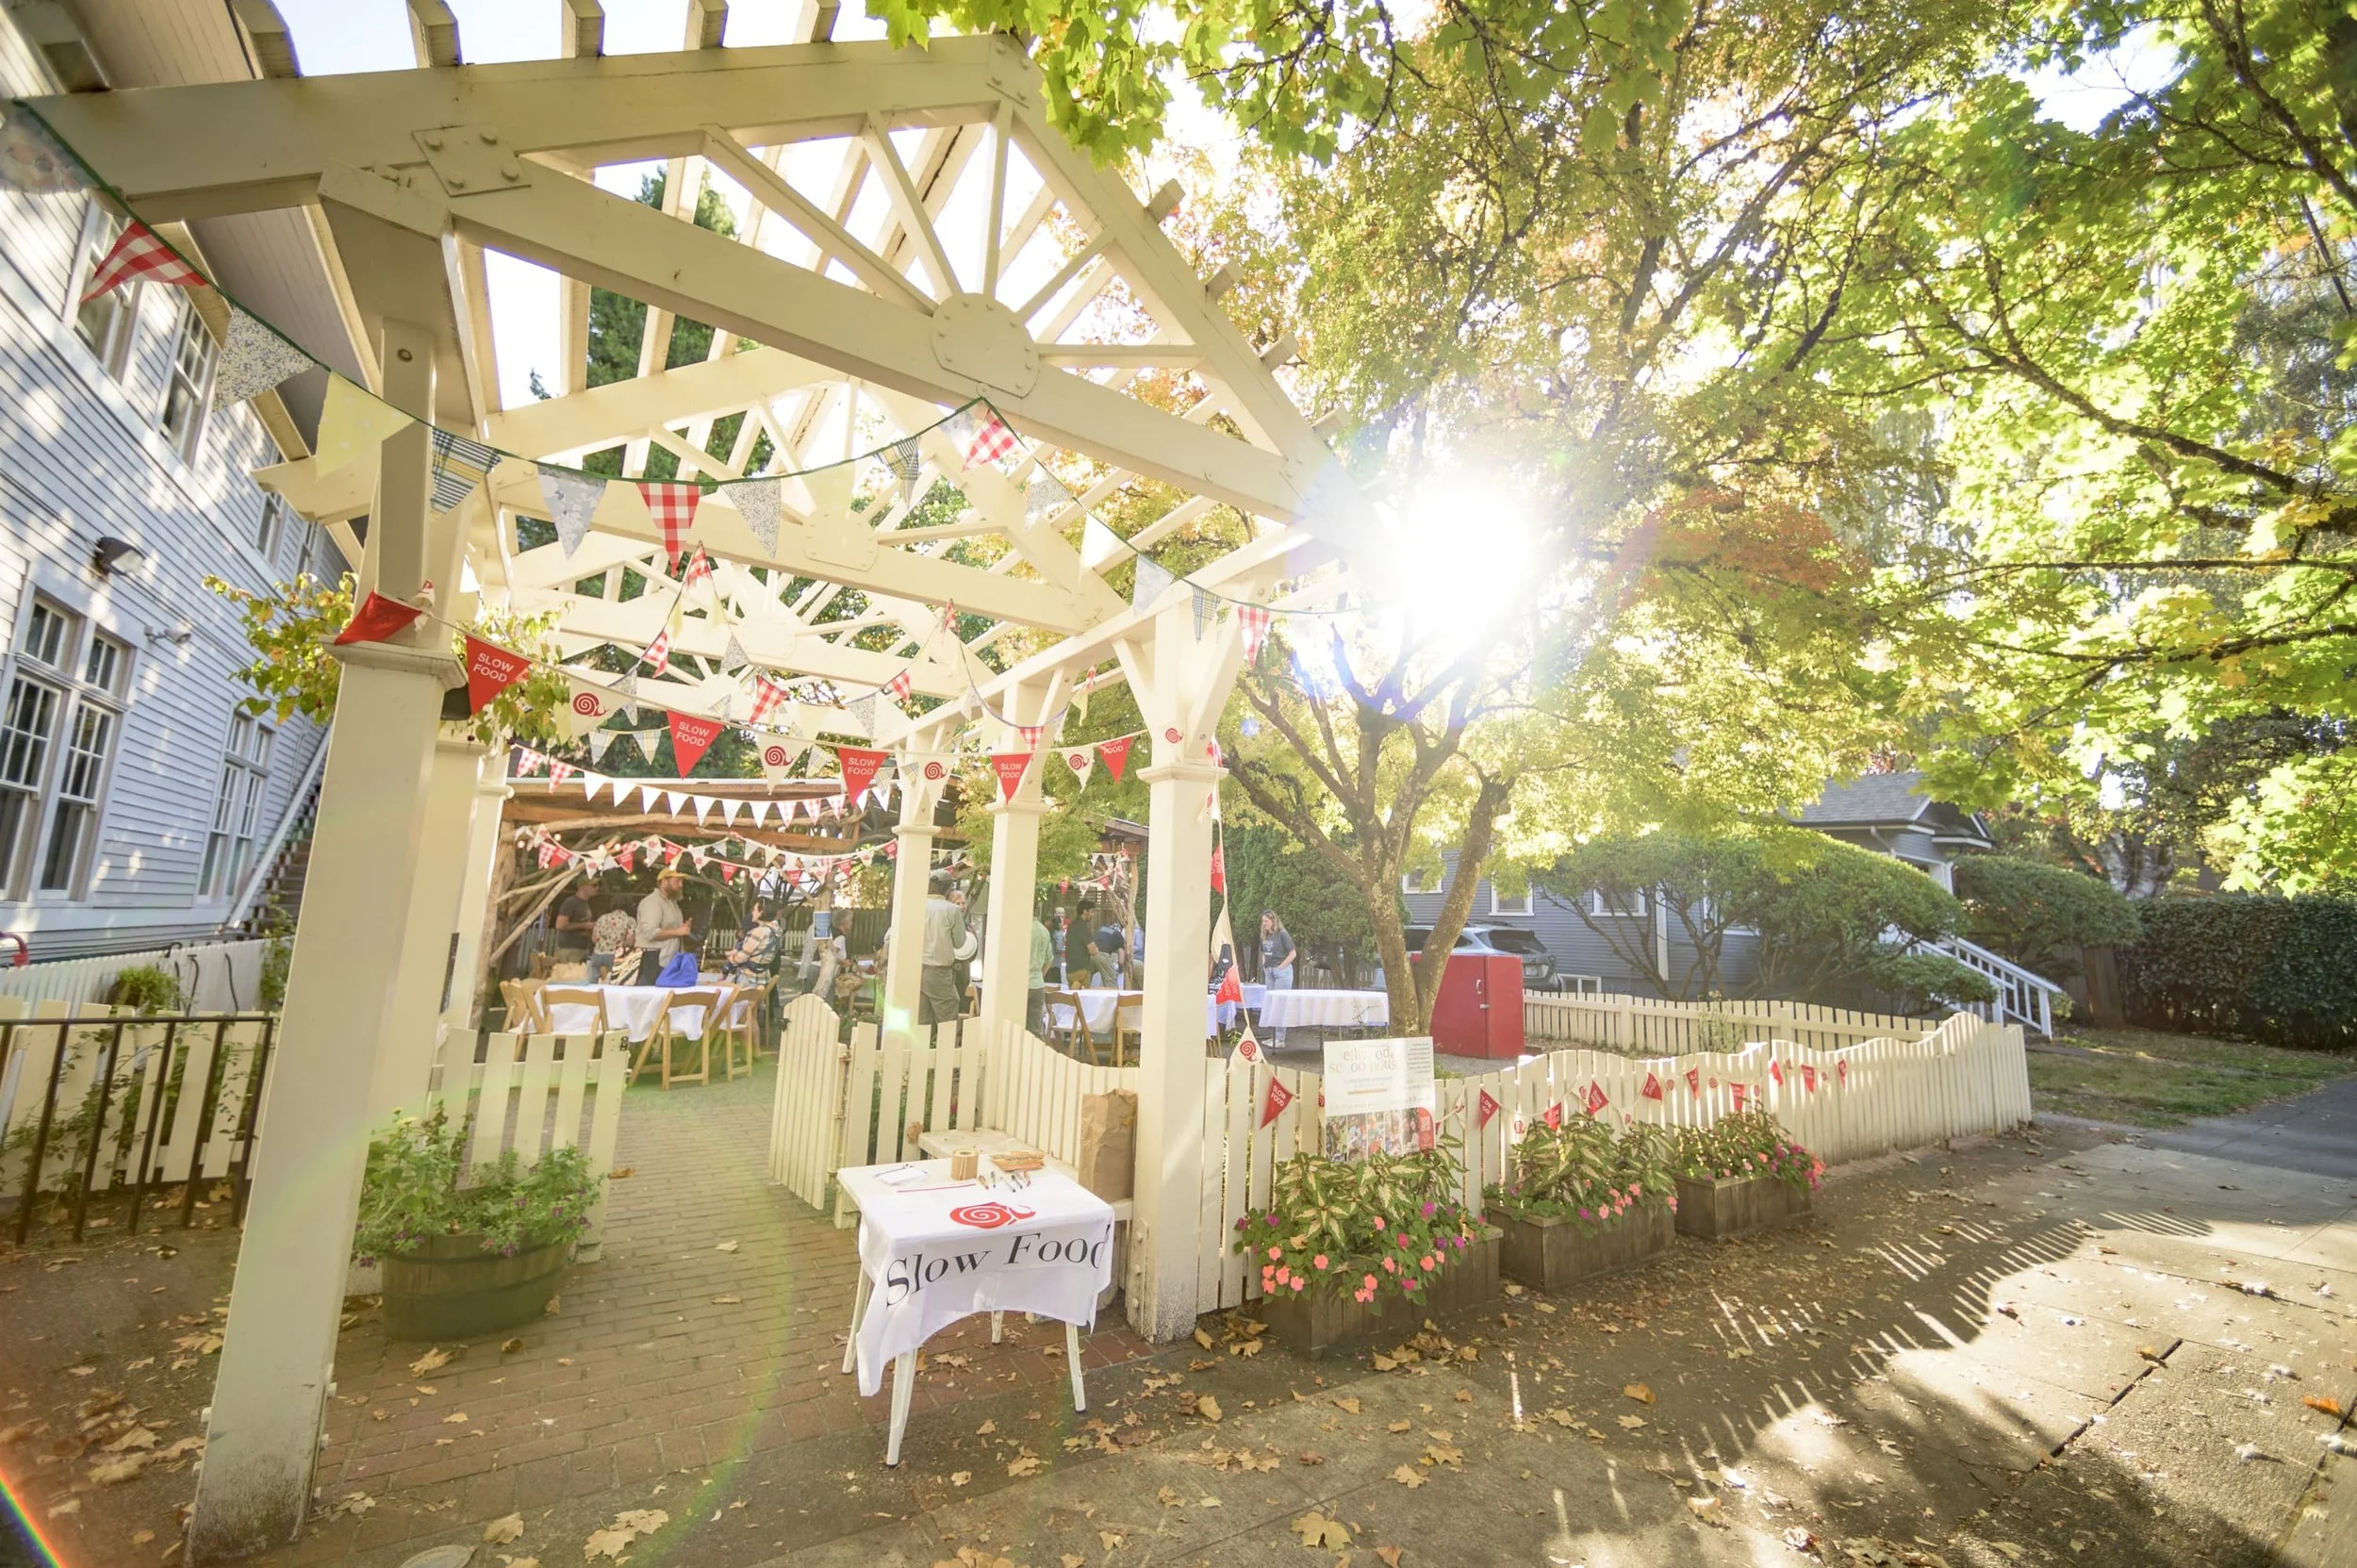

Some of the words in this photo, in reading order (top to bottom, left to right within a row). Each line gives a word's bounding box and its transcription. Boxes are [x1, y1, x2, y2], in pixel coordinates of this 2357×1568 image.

[478, 652, 514, 672] SLOW
[473, 663, 507, 682] FOOD
[679, 721, 709, 736] SLOW
[676, 732, 705, 747] FOOD
[849, 757, 876, 767] SLOW
[849, 767, 874, 775] FOOD
[885, 1249, 993, 1309] Slow
